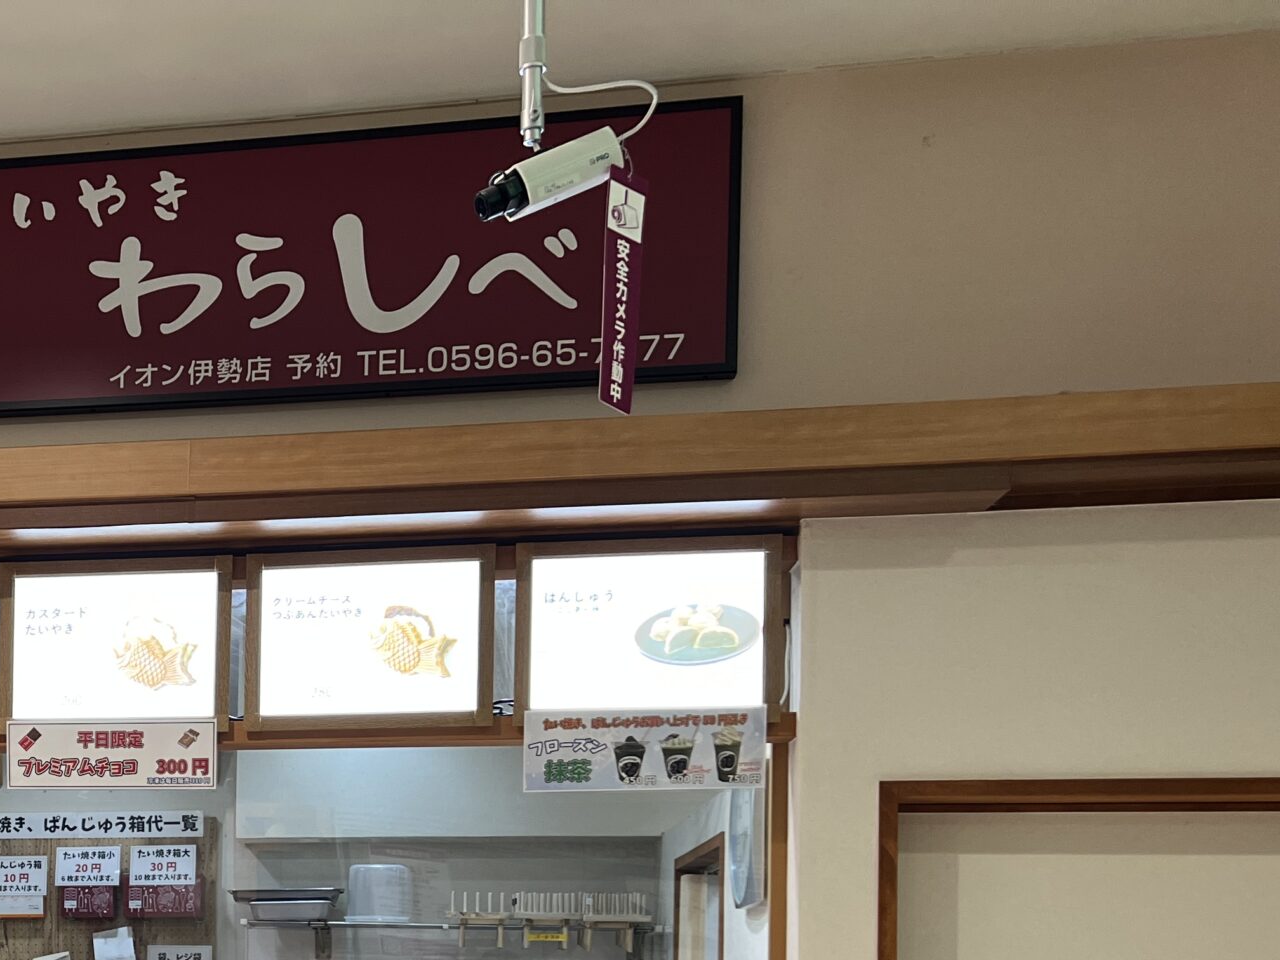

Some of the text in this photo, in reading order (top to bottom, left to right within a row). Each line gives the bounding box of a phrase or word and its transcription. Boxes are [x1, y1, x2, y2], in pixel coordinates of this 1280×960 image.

[88, 213, 579, 337] わらしべ
[610, 239, 630, 403] 安全カメラ作動中
[109, 333, 686, 389] イオン伊勢店 予約 TEL.0596-65-777
[273, 595, 351, 606] クリームチーズ
[25, 607, 87, 619] カスタード
[25, 624, 73, 636] たいやき
[76, 730, 144, 749] 平日限定
[528, 738, 607, 757] フローズン
[18, 756, 209, 778] プレミアムチョコ 300円
[544, 759, 593, 783] 抹茶
[63, 850, 115, 860] たい焼き箱小
[137, 849, 191, 859] たい焼き箱大
[75, 863, 101, 873] 20円
[150, 862, 177, 872] 30円
[3, 873, 29, 883] 10円
